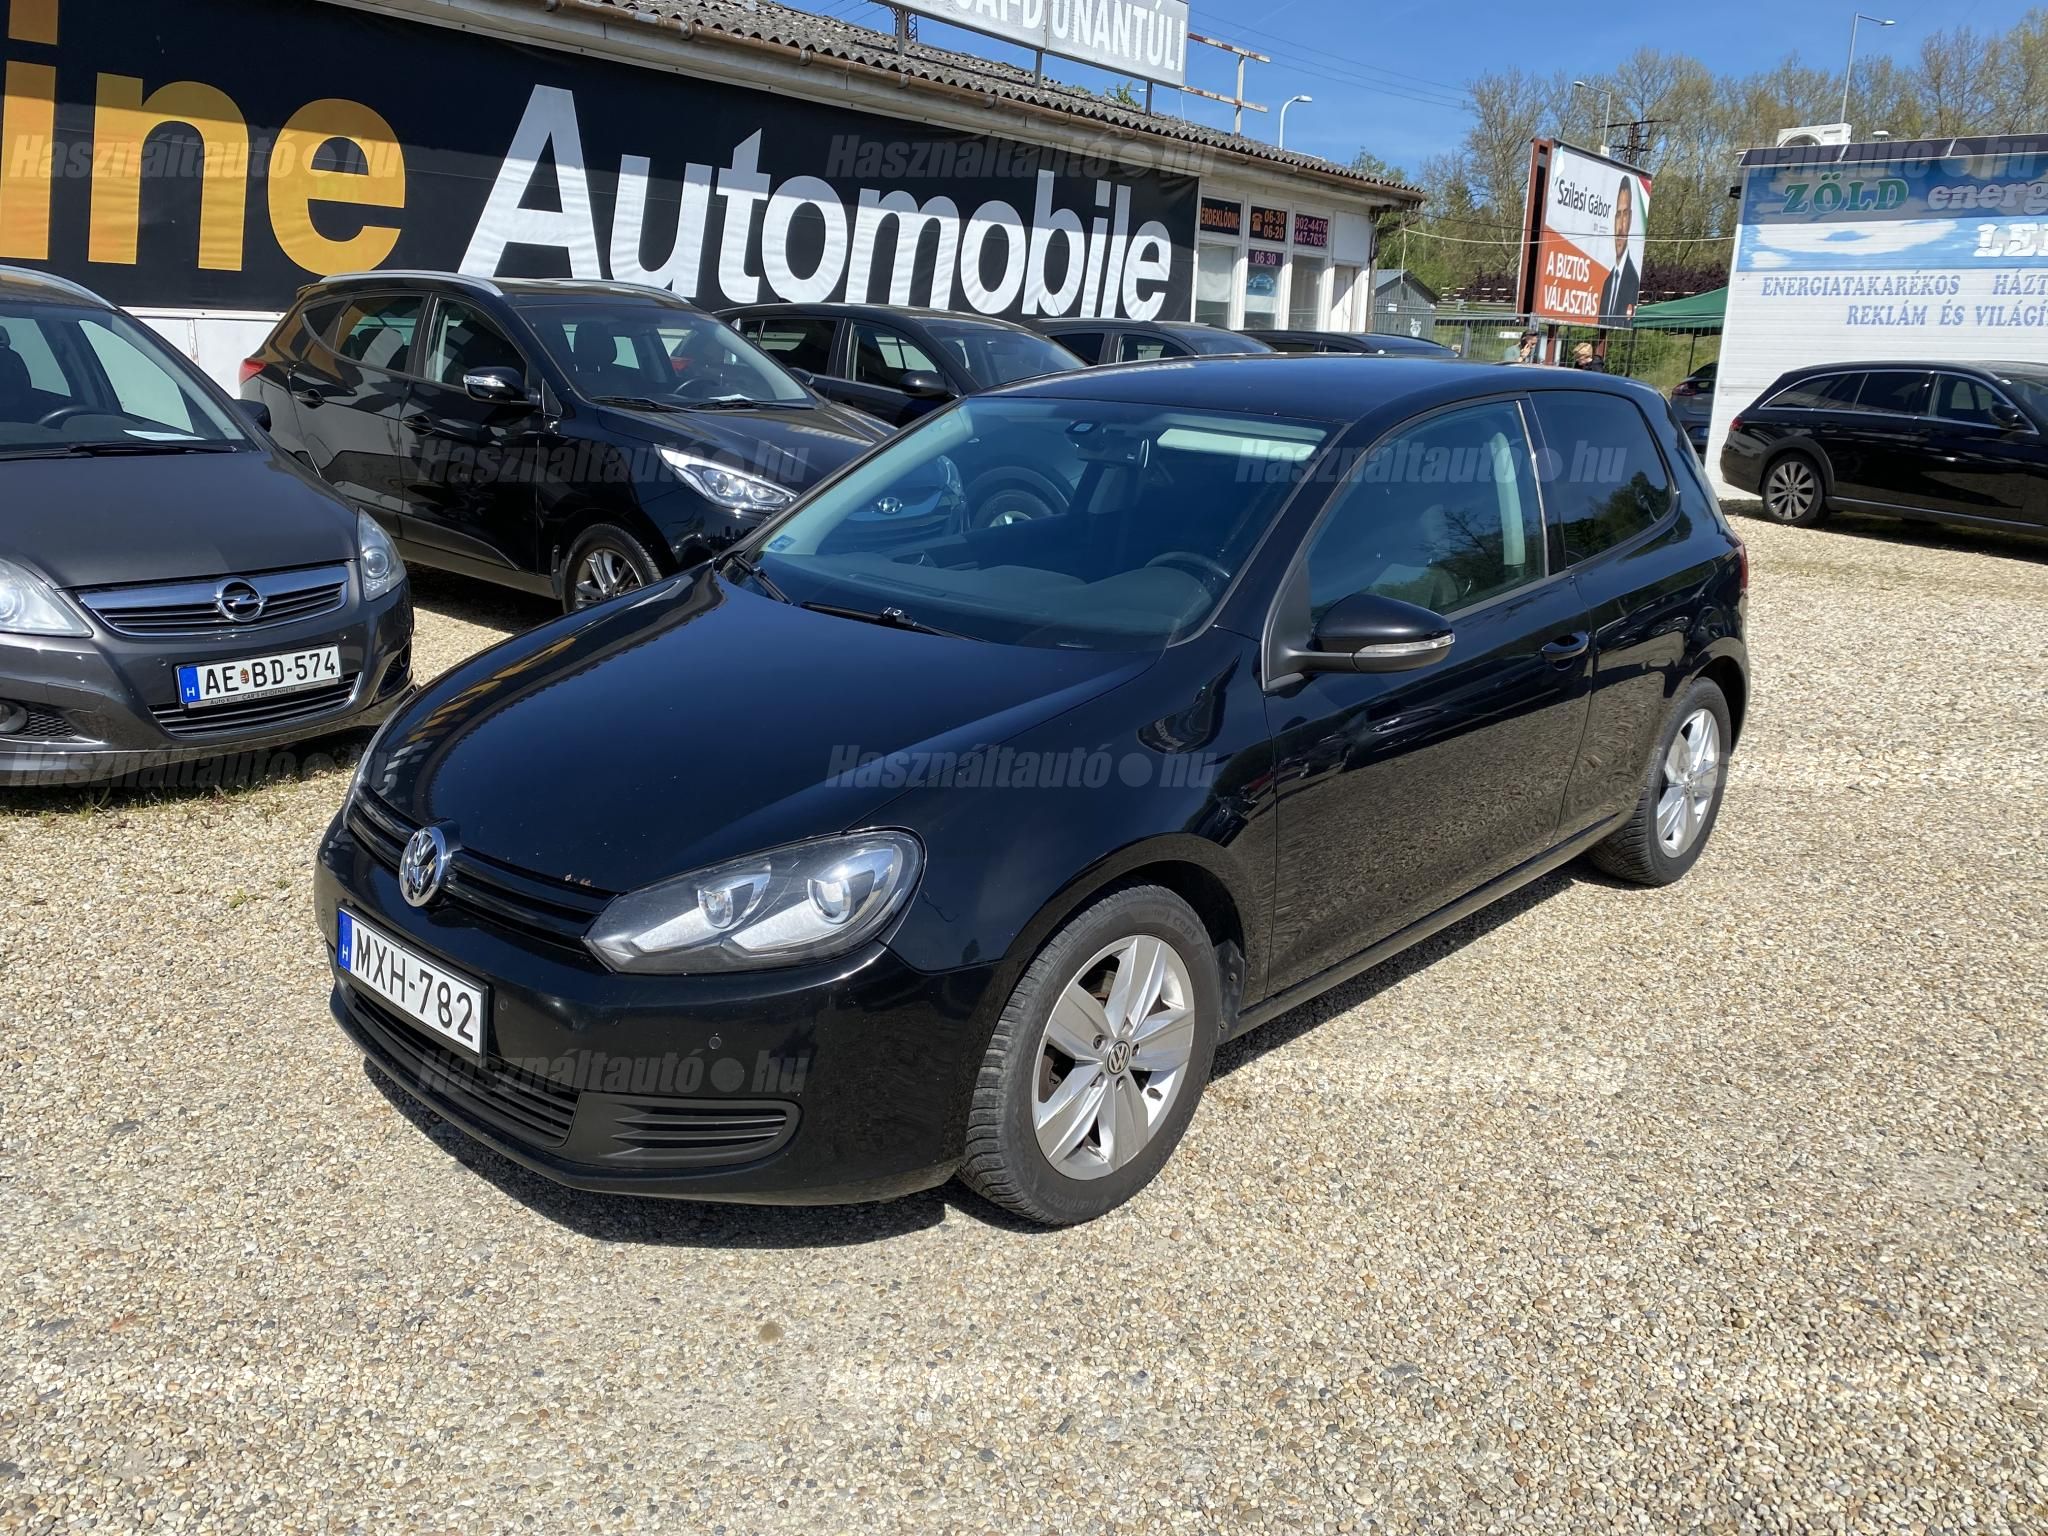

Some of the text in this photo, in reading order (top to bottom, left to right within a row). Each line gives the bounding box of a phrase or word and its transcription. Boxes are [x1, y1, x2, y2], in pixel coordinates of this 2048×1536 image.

[457, 84, 1172, 322] Automobile
[1557, 179, 1611, 219] Szilasi Gábor
[1781, 172, 1909, 215] ZÖLD
[1263, 225, 1284, 239] 06-20
[1264, 210, 1285, 224] 06-30
[1255, 252, 1277, 265] 06 30
[1546, 252, 1591, 282] A BIZTOS
[1544, 281, 1597, 316] VÁLASZTÁS
[1761, 270, 1961, 297] ENERGIATAKARÉKOS
[1846, 300, 1928, 326] REKLÁM
[1939, 299, 1966, 326] ÉS
[186, 650, 336, 697] H AE BD-574
[341, 927, 474, 1043] H MXH-782
